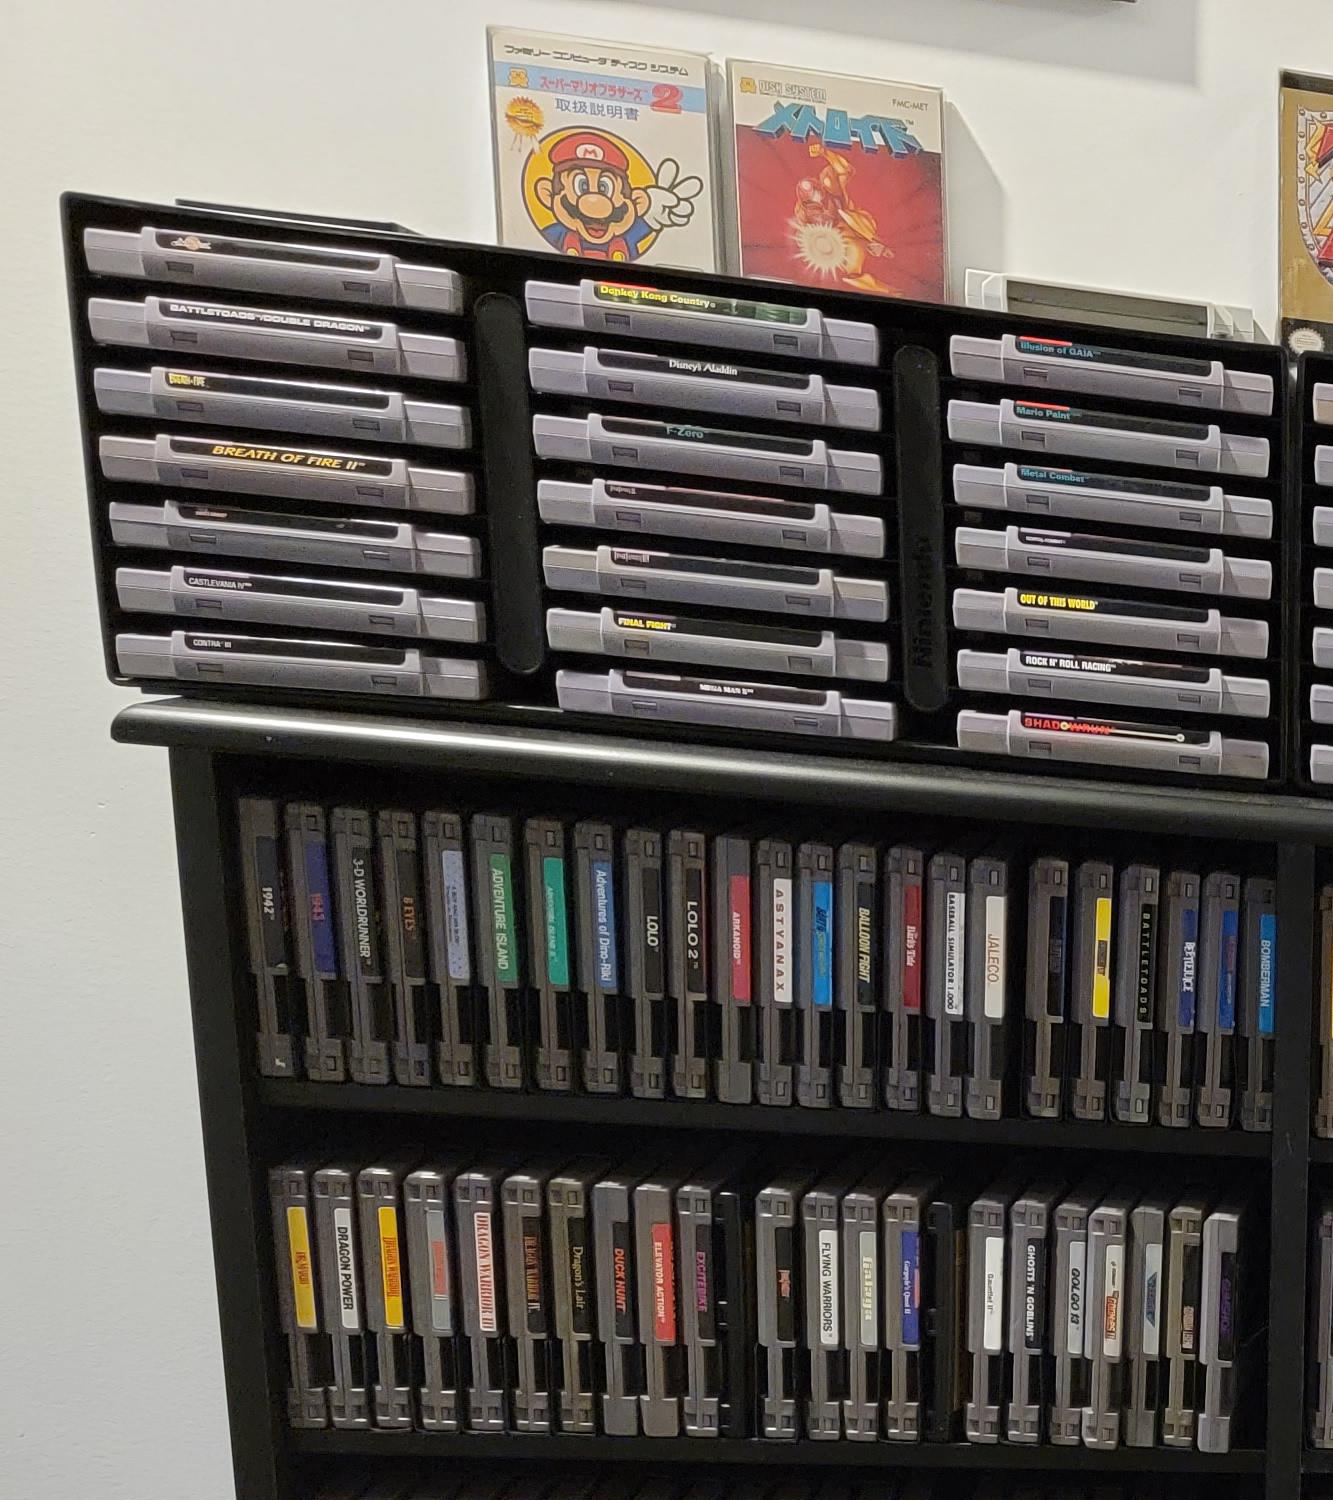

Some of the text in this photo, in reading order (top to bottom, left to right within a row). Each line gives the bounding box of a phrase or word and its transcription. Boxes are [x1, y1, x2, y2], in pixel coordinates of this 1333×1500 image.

[759, 80, 826, 102] DISK SYSTEM
[555, 98, 640, 121] 取扱説明書
[892, 98, 928, 112] FMC-MET
[600, 286, 711, 308] Donkey Kong Country
[1016, 406, 1071, 420] Mario Paint
[666, 425, 704, 440] F-Zero
[212, 445, 276, 460] BREATH
[279, 452, 304, 463] OF
[306, 456, 342, 468] FIRE
[1020, 594, 1095, 610] OUT OF THIS WORLD
[492, 869, 509, 970] ADVENTURE ISLAND
[774, 888, 785, 991] ASTYANAX
[987, 933, 999, 984] JALECO
[1259, 939, 1272, 1008] BOMBERMAN
[613, 1248, 626, 1313] DUCK HUNT
[821, 1241, 833, 1332] FLYING WARRIORS
